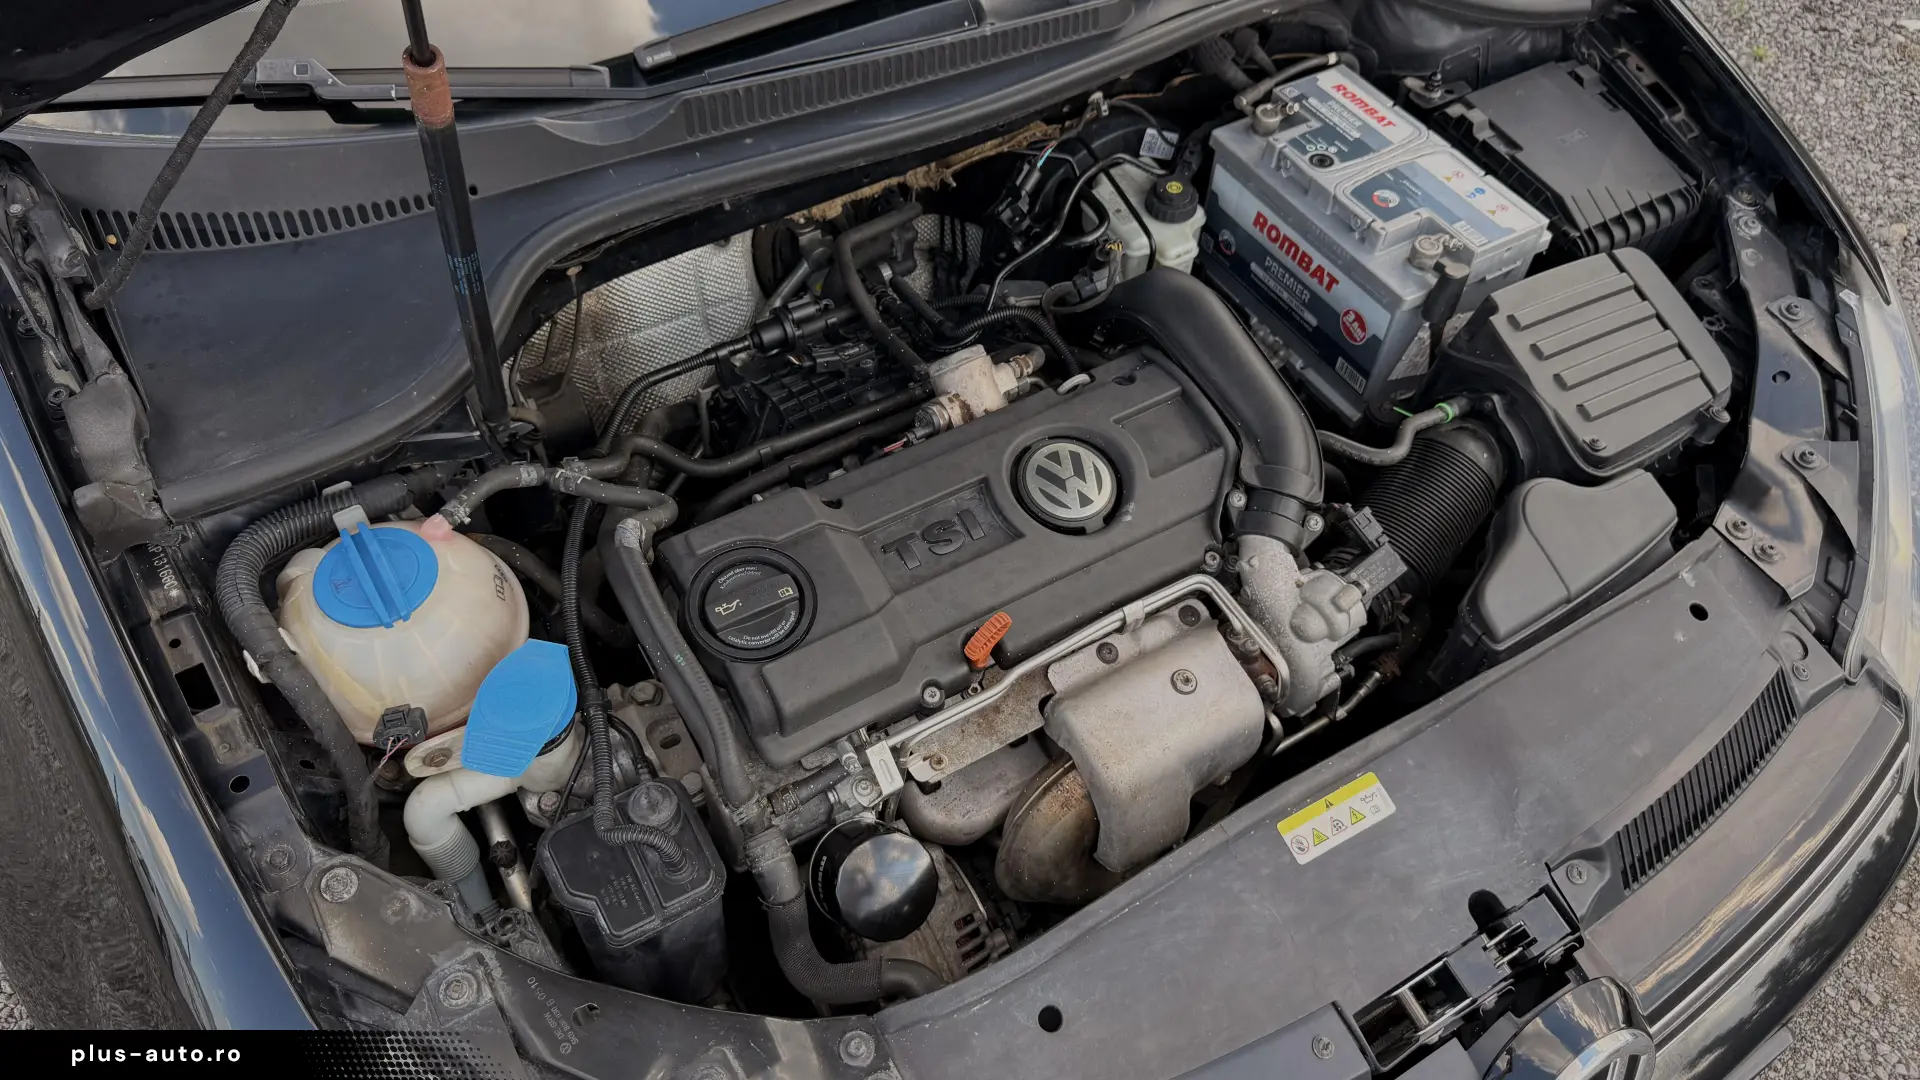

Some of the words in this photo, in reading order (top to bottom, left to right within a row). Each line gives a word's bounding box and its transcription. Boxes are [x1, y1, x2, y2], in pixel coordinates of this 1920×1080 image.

[1331, 84, 1397, 128] ROMBAT
[1252, 211, 1340, 294] ROMBAT
[1264, 255, 1311, 304] PREMIER
[881, 509, 986, 571] TSI
[544, 1011, 558, 1028] GRW
[546, 998, 556, 1006] B
